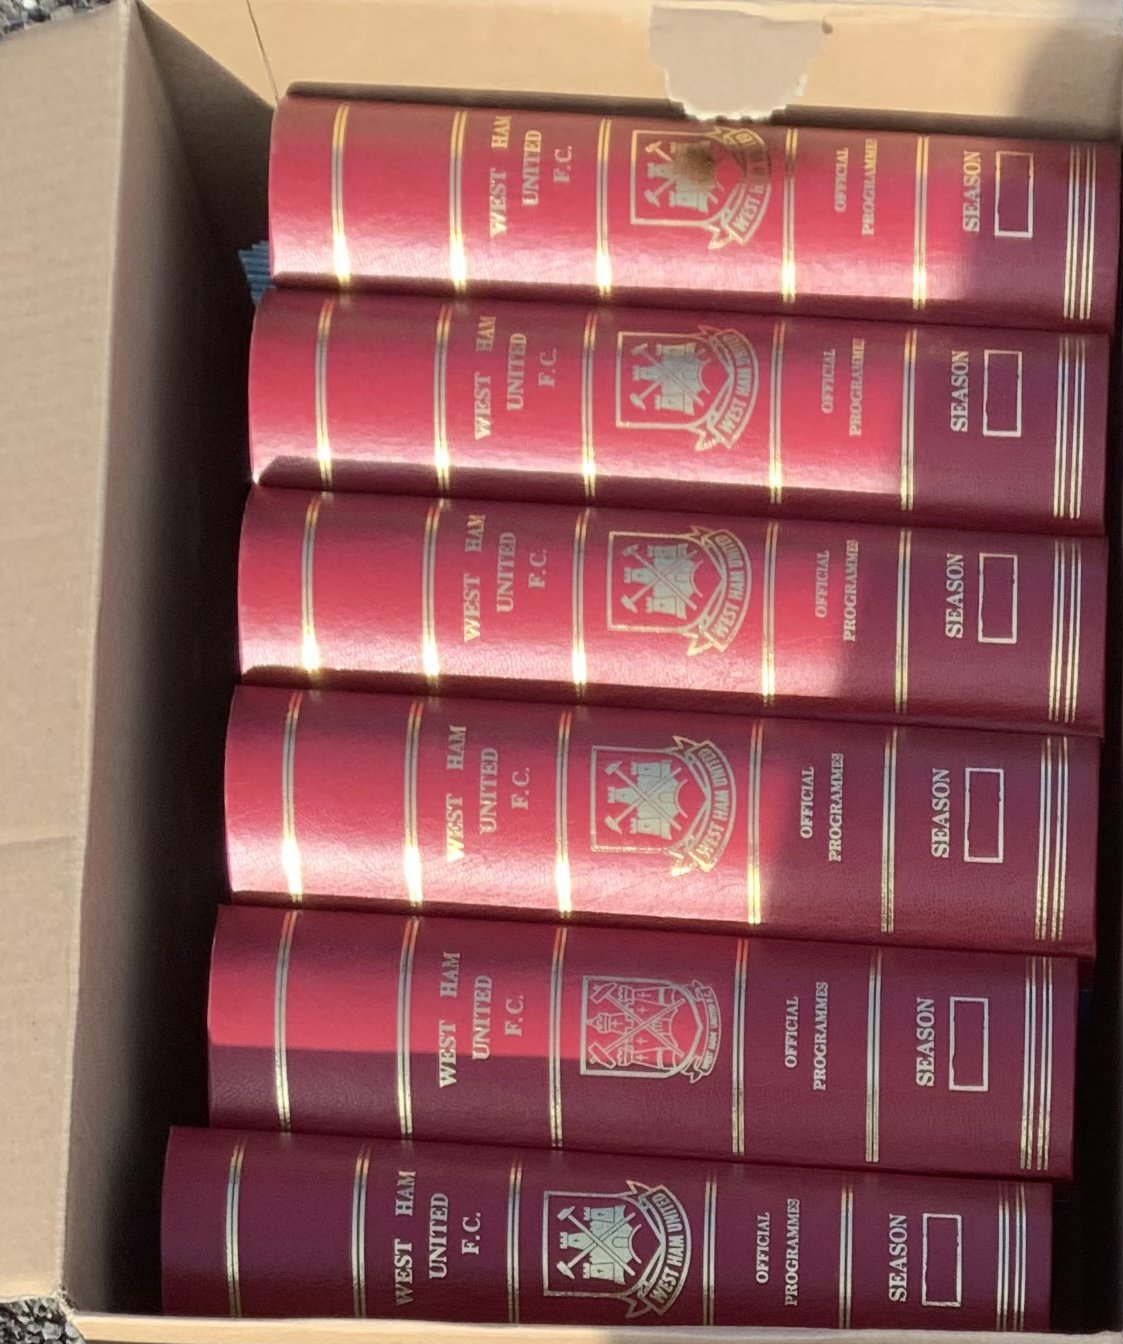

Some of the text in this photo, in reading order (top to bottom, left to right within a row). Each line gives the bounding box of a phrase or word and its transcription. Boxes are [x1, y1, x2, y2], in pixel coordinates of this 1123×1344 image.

[522, 130, 542, 206] UNITED
[963, 151, 981, 232] SEASON
[507, 333, 527, 410] UNITED
[950, 351, 969, 432] SEASON
[496, 532, 516, 612] UNITED
[945, 553, 964, 638] SEASON
[446, 725, 466, 862] WEST HAM
[480, 748, 498, 834] UNITED
[800, 767, 814, 838] OFFICIAL
[931, 768, 950, 858] SEASON
[439, 952, 460, 1088] WEST HAM
[472, 976, 492, 1059] UNITED
[813, 982, 828, 1090] PROGRAMMES
[916, 997, 934, 1086] SEASON
[394, 1171, 416, 1303] WEST HAM
[429, 1193, 448, 1278] UNITED
[756, 1212, 770, 1283] OFFICIAL
[889, 1214, 907, 1302] SEASON
